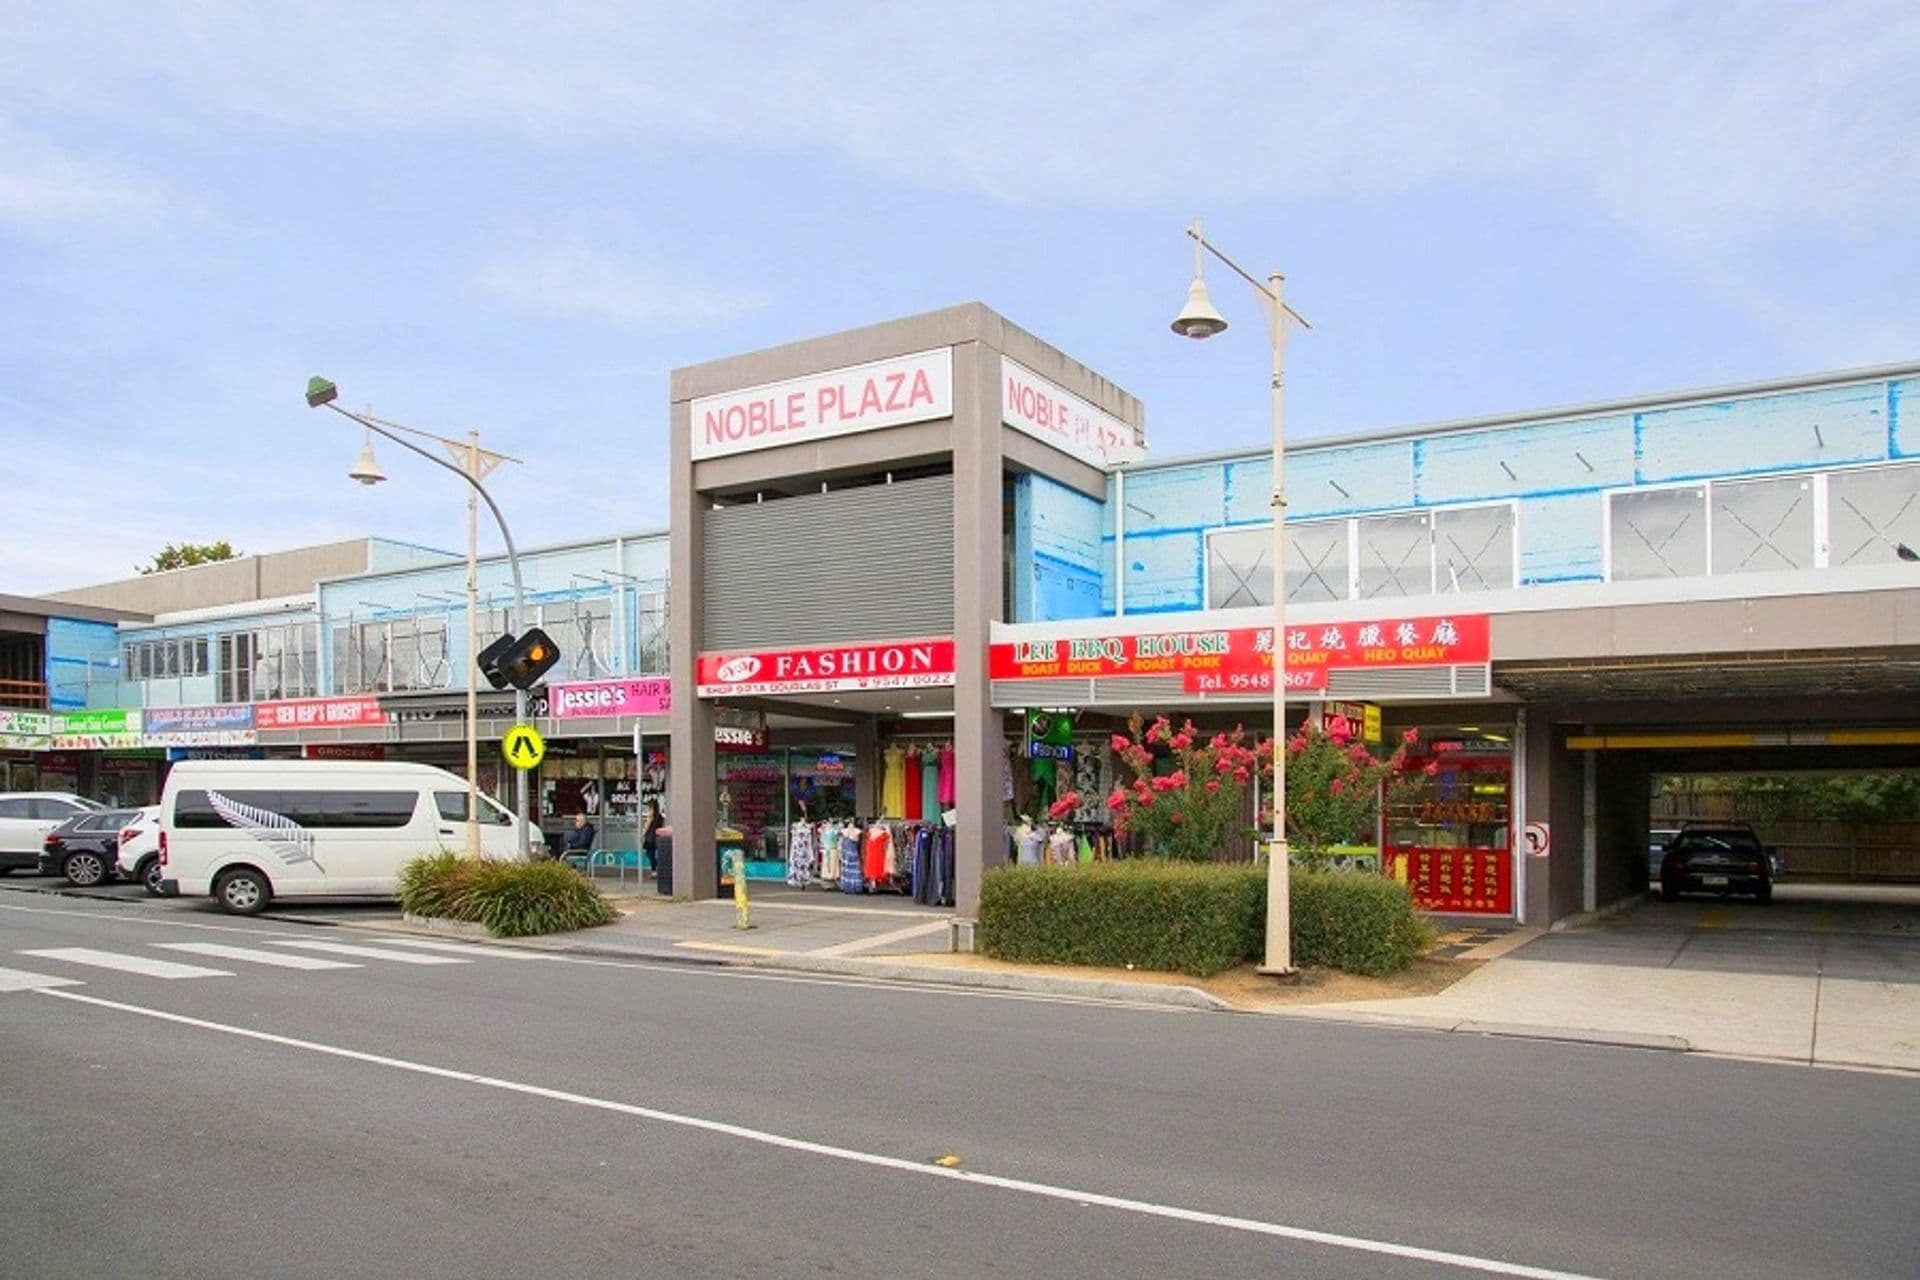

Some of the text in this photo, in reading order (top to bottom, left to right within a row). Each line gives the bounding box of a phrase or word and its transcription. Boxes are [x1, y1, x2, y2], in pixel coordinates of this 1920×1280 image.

[705, 368, 935, 445] NOBLE PLAZA
[1008, 376, 1069, 438] NOBLE
[1014, 631, 1230, 663] LEE BBQ HOUSE
[1290, 651, 1329, 664] QUAY
[1364, 648, 1397, 661] HEO
[1402, 646, 1447, 660] QUAY
[776, 646, 934, 678] FASHION
[1022, 663, 1060, 675] ROAST
[1067, 661, 1102, 673] DUCK
[1134, 658, 1175, 671] ROAST
[1184, 656, 1221, 668] PORK
[770, 680, 820, 692] DOUGLAS
[825, 680, 840, 690] ST
[1197, 671, 1314, 689] Tel. 9548 867
[556, 685, 626, 716] Jessie's
[631, 683, 660, 697] HAIR
[715, 727, 763, 746] essie's
